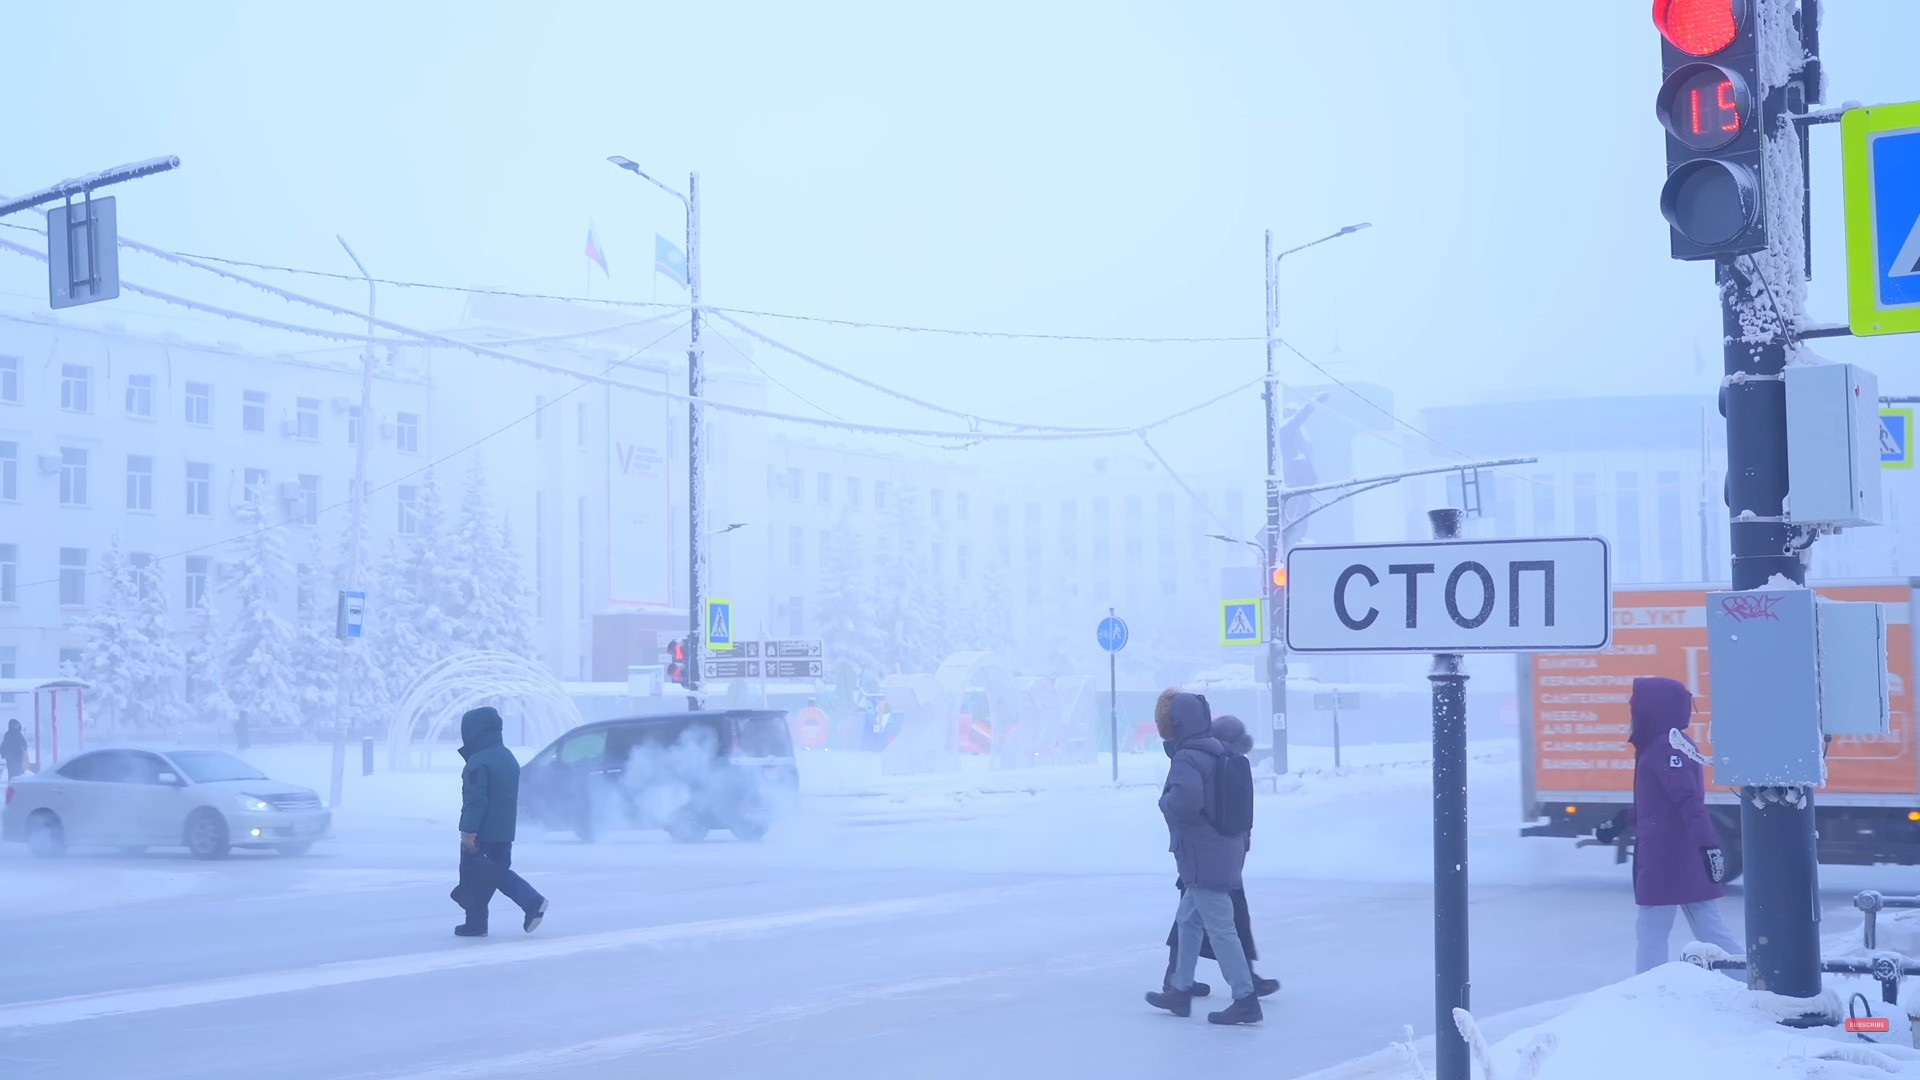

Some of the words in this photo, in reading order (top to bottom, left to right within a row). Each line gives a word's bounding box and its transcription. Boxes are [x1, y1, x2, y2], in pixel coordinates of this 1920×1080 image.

[1691, 80, 1741, 134] 15
[1333, 560, 1555, 630] СТОП
[1541, 693, 1630, 704] САНТЕХНИК
[1541, 710, 1598, 721] МЕБЕЛЬ
[1597, 758, 1609, 769] И
